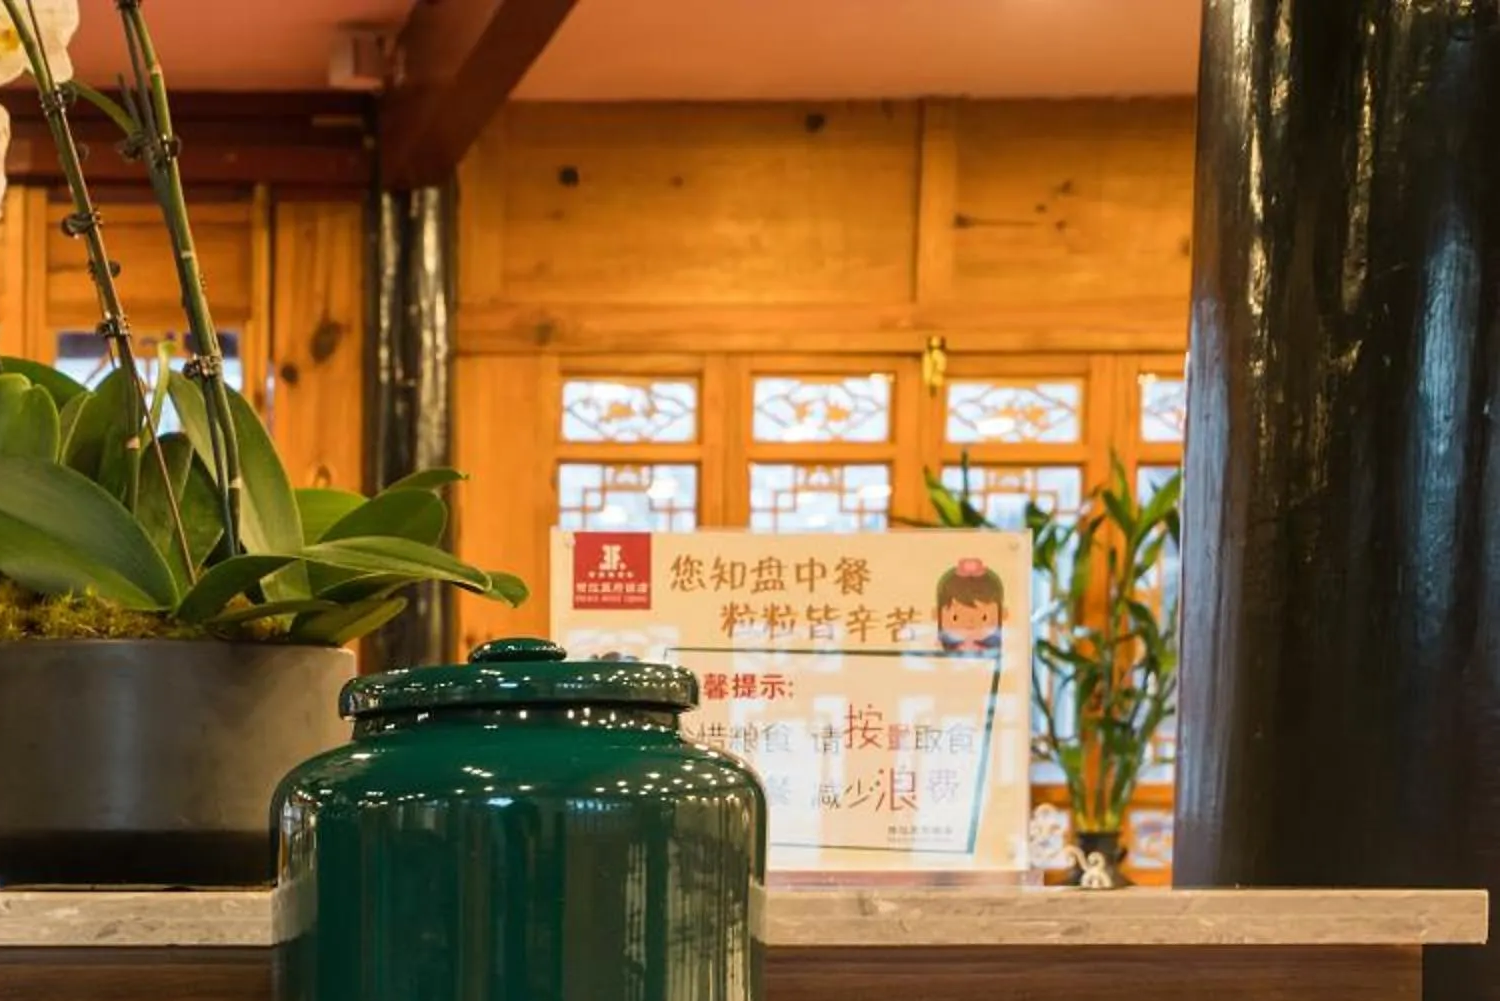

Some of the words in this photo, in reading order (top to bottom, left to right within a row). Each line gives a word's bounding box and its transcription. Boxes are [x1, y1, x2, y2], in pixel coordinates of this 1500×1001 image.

[669, 553, 872, 595] 您知盘中餐
[720, 601, 923, 643] 粒粒皆辛苦
[684, 722, 792, 754] 惜粮食
[810, 764, 960, 812] 减少浪费
